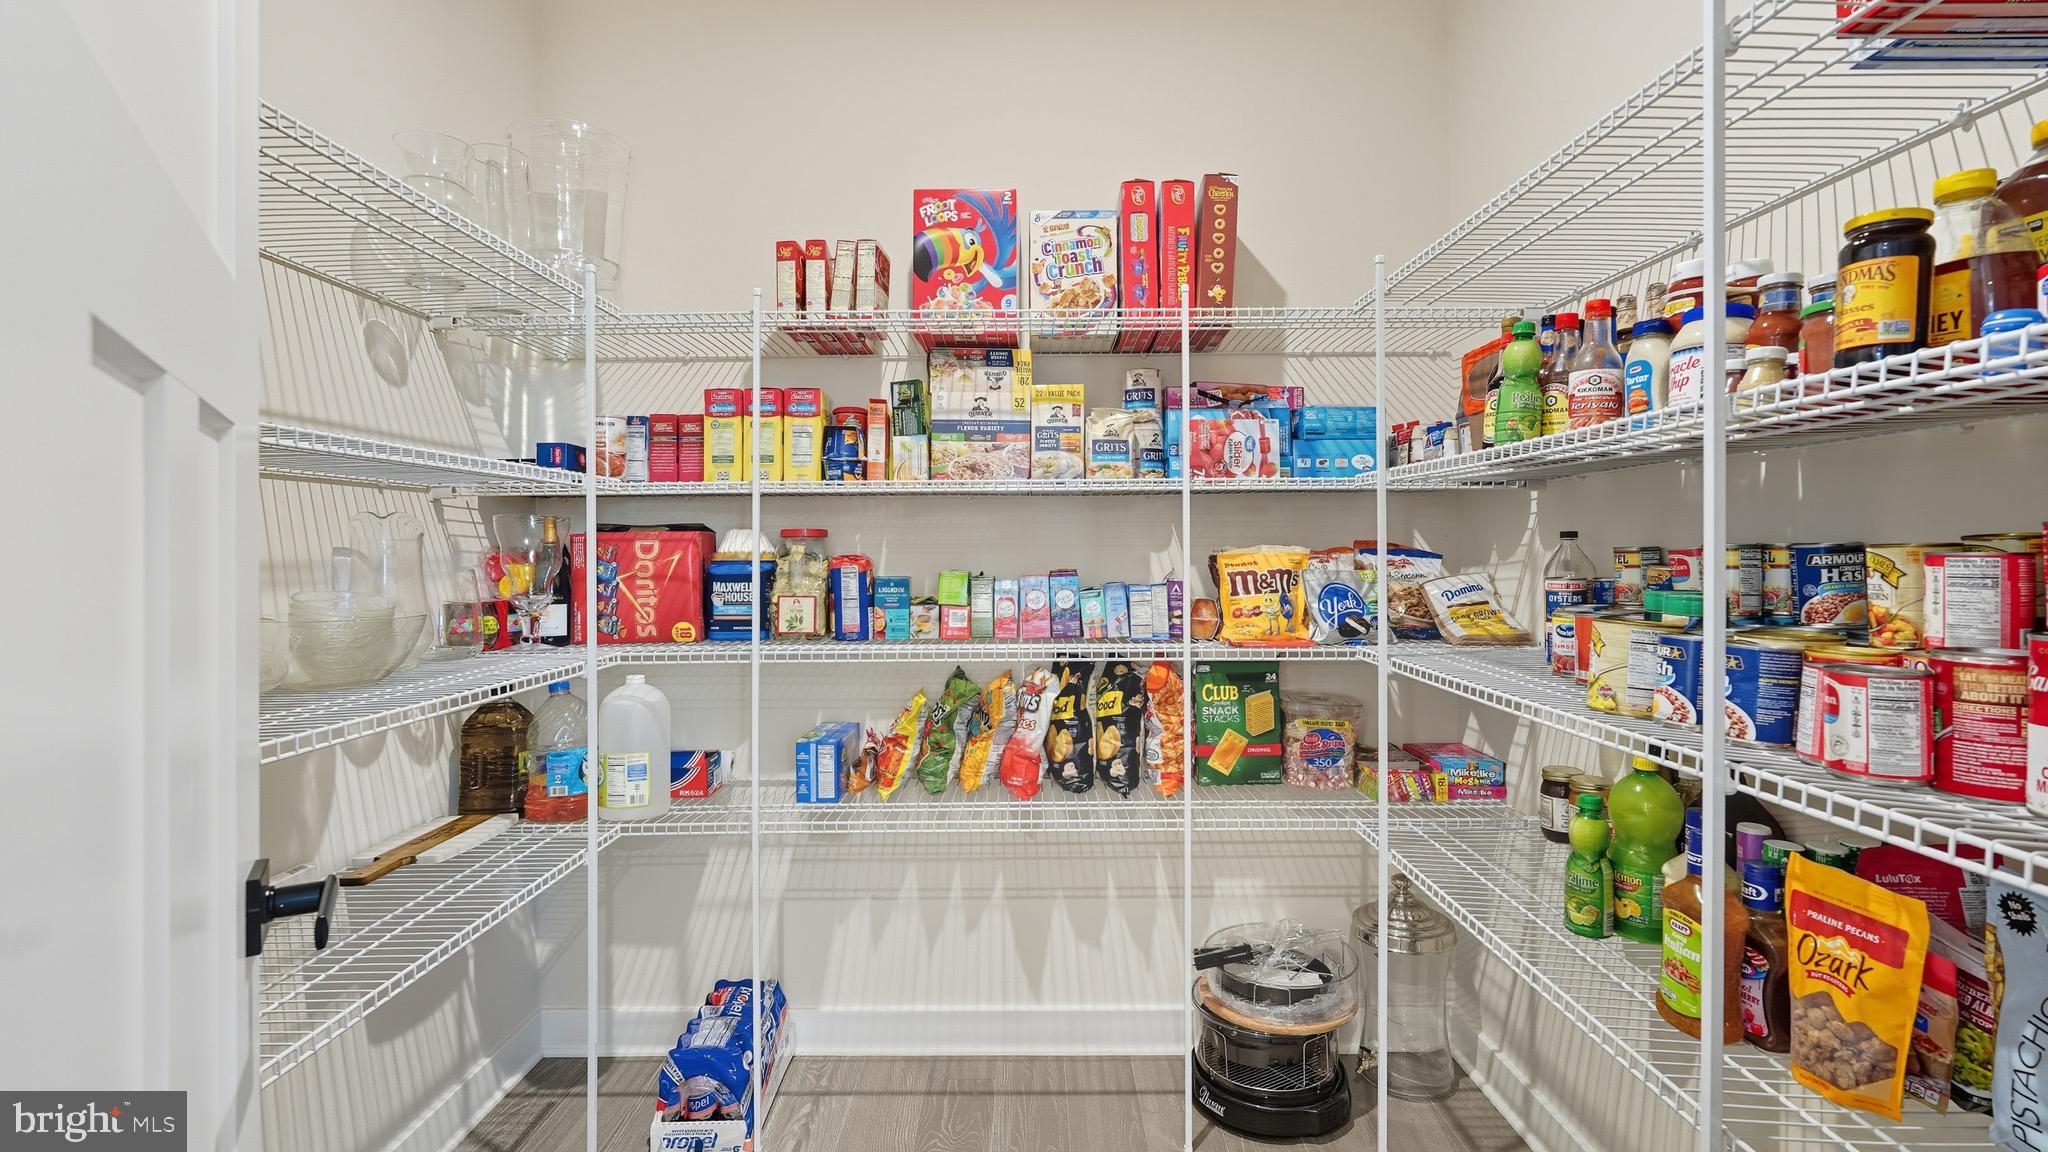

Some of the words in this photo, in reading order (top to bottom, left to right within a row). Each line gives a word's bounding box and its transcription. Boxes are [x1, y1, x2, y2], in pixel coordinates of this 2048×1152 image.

[919, 199, 957, 219] FROOT
[924, 210, 958, 227] LOOPS
[1042, 235, 1103, 256] Cinnamon
[1055, 249, 1093, 265] Toast
[1047, 256, 1104, 280] Crunch
[1841, 263, 1897, 284] NDMAS
[1671, 355, 1701, 374] racle
[1671, 374, 1690, 392] hip
[1014, 398, 1025, 408] 52
[1126, 390, 1153, 400] GRITS
[1095, 442, 1126, 451] GRITS
[1143, 451, 1164, 459] GRIT
[635, 539, 660, 638] Doritos
[1441, 583, 1484, 602] Domino
[1549, 595, 1583, 603] OYSTERS
[1320, 591, 1363, 631] York
[1202, 684, 1239, 702] CLUB
[1202, 706, 1239, 714] SNACK
[1202, 714, 1240, 723] STACKS
[1314, 758, 1332, 767] 350
[1806, 909, 1843, 929] PRALINE
[1844, 924, 1880, 944] PECANS
[1797, 933, 1874, 991] Ozark
